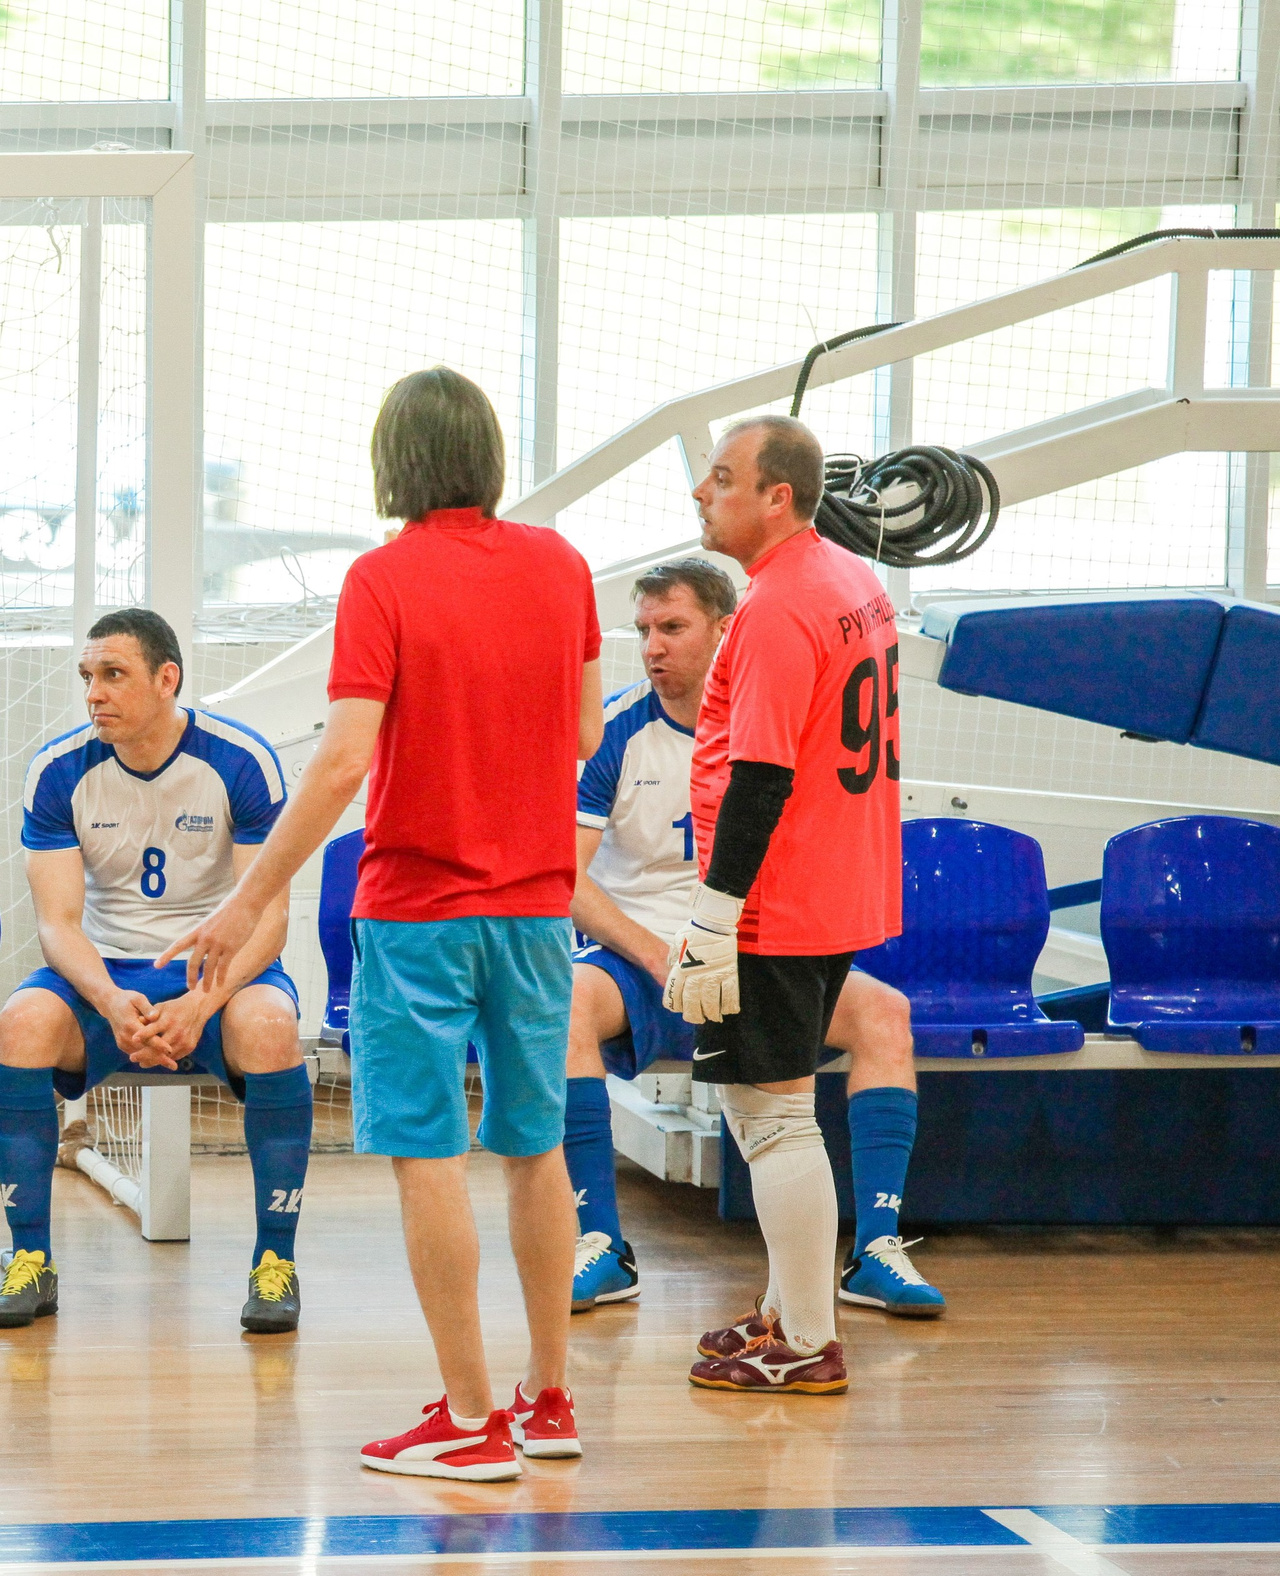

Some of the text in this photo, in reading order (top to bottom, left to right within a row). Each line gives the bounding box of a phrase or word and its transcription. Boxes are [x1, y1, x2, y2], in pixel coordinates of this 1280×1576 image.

[837, 643, 900, 794] 95
[140, 847, 167, 898] 8
[749, 1125, 786, 1151] adidas
[1, 1183, 18, 1207] K
[267, 1188, 304, 1213] 2K
[873, 1192, 902, 1215] 2K
